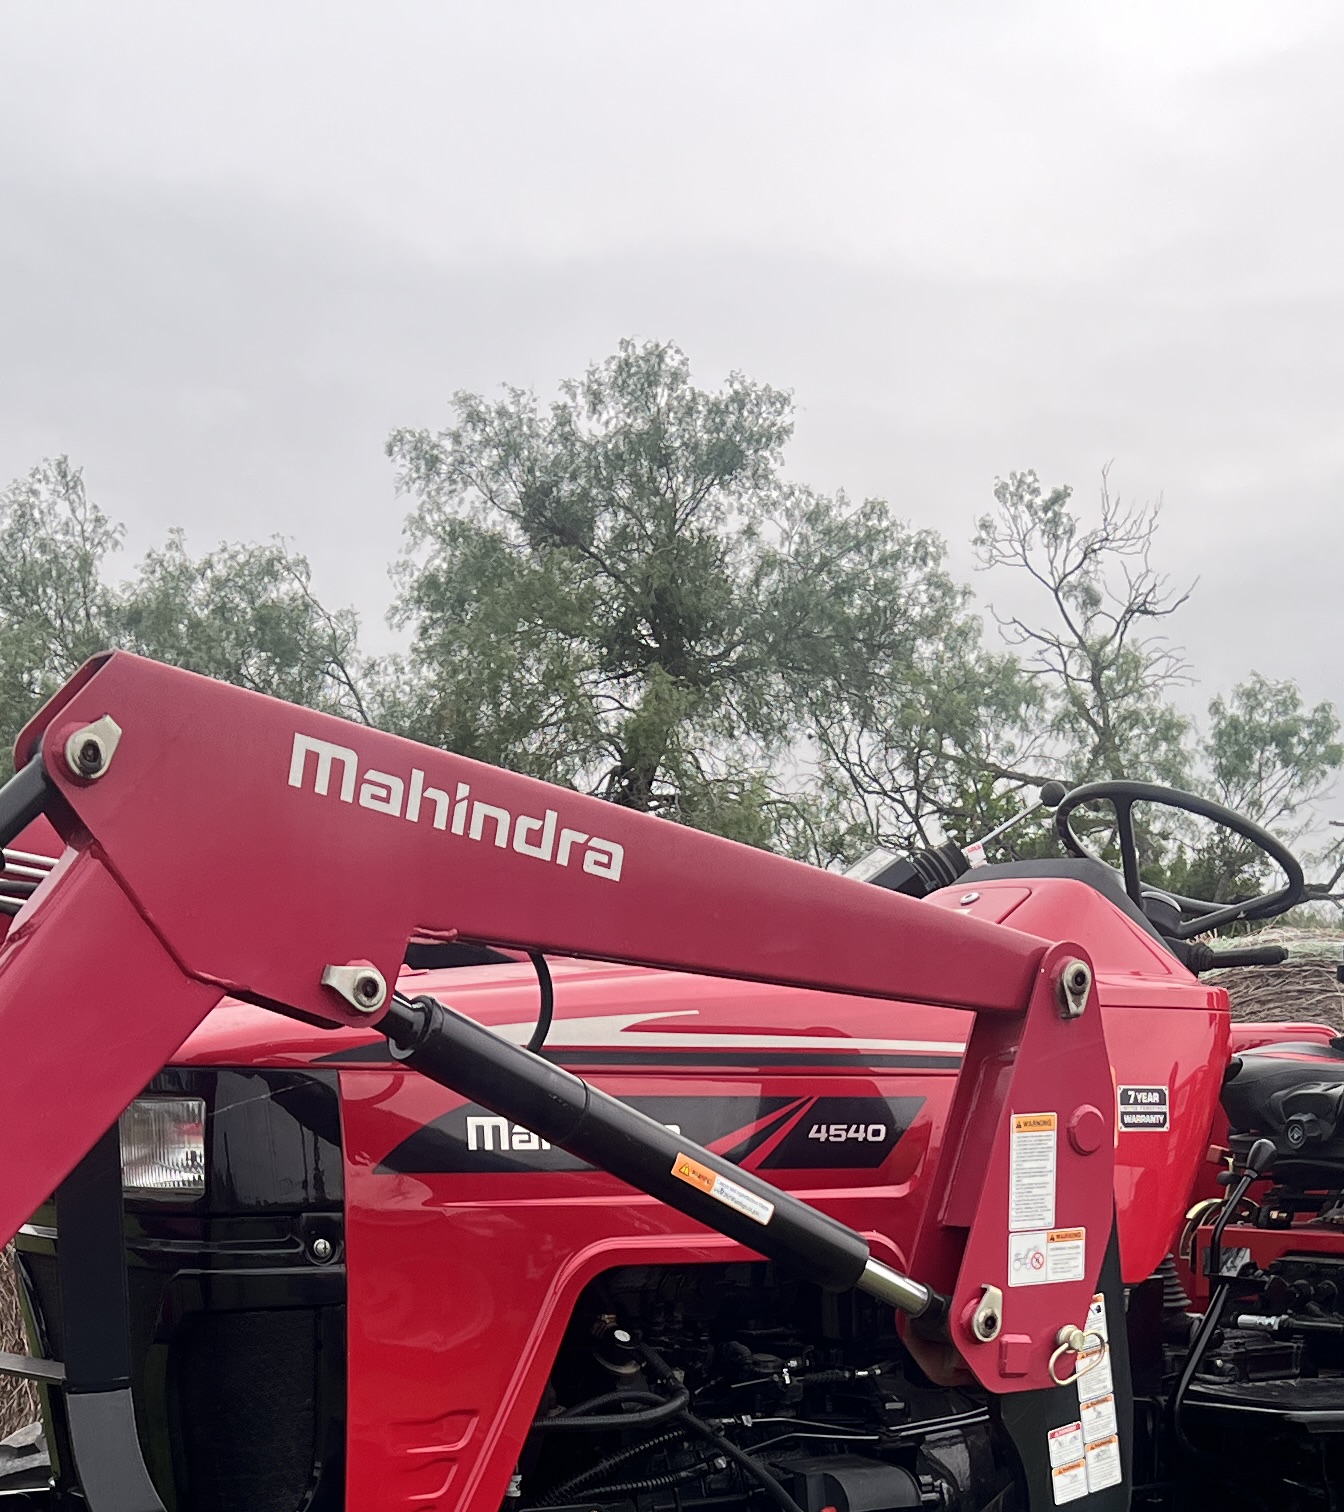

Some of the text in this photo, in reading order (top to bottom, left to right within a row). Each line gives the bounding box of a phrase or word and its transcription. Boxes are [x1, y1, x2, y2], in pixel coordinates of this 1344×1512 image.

[287, 732, 625, 882] Mahindra
[1127, 1090, 1160, 1104] 7 YEAR
[1123, 1114, 1165, 1124] WARRANTY
[808, 1123, 887, 1142] 4540
